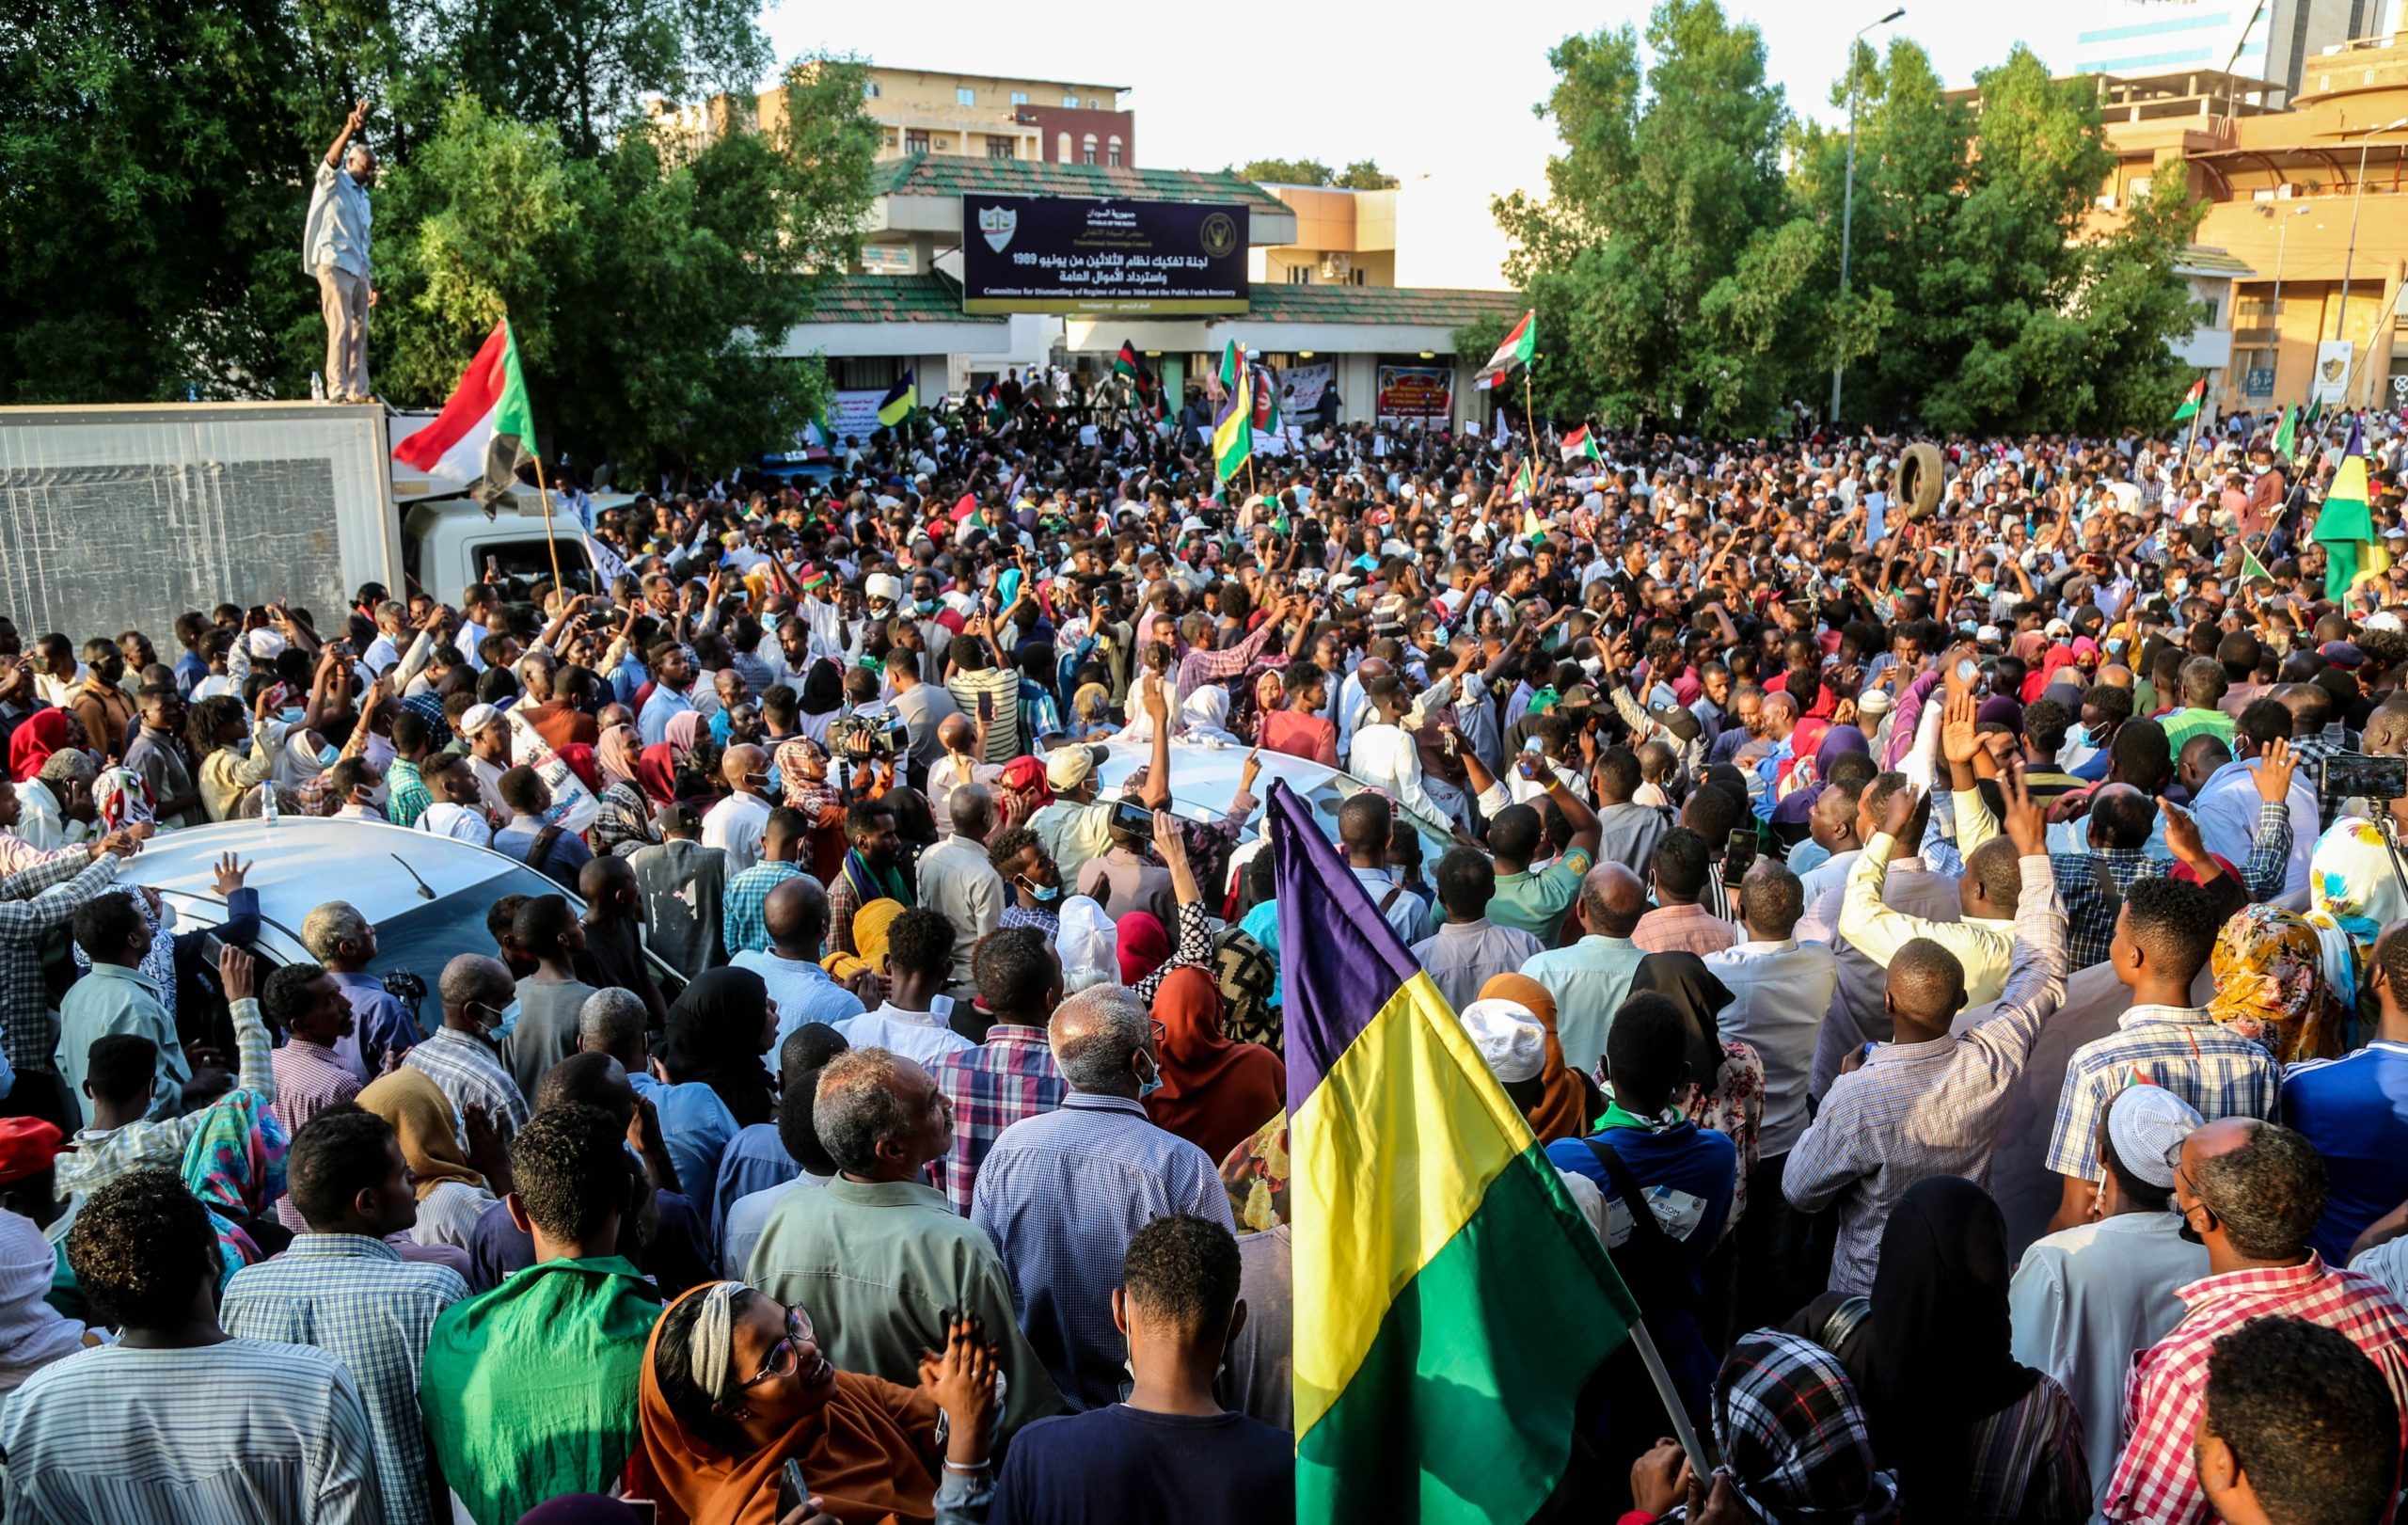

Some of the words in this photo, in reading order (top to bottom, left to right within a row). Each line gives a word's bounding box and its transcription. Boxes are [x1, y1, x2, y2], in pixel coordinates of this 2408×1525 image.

[1012, 252, 1038, 264] 1989
[1038, 254, 1068, 268] يونيو
[1069, 255, 1085, 268] من
[1086, 252, 1124, 268] الثلاثين
[1126, 254, 1150, 269] نظام
[1152, 255, 1184, 270] تفكيك
[1186, 255, 1209, 270] لجنة
[1059, 270, 1090, 282] العامة
[1091, 267, 1124, 285] الأموال
[1126, 271, 1168, 285] واسترداد
[984, 287, 1022, 295] Committee
[1022, 287, 1034, 295] for
[1665, 1203, 1681, 1217] IOM
